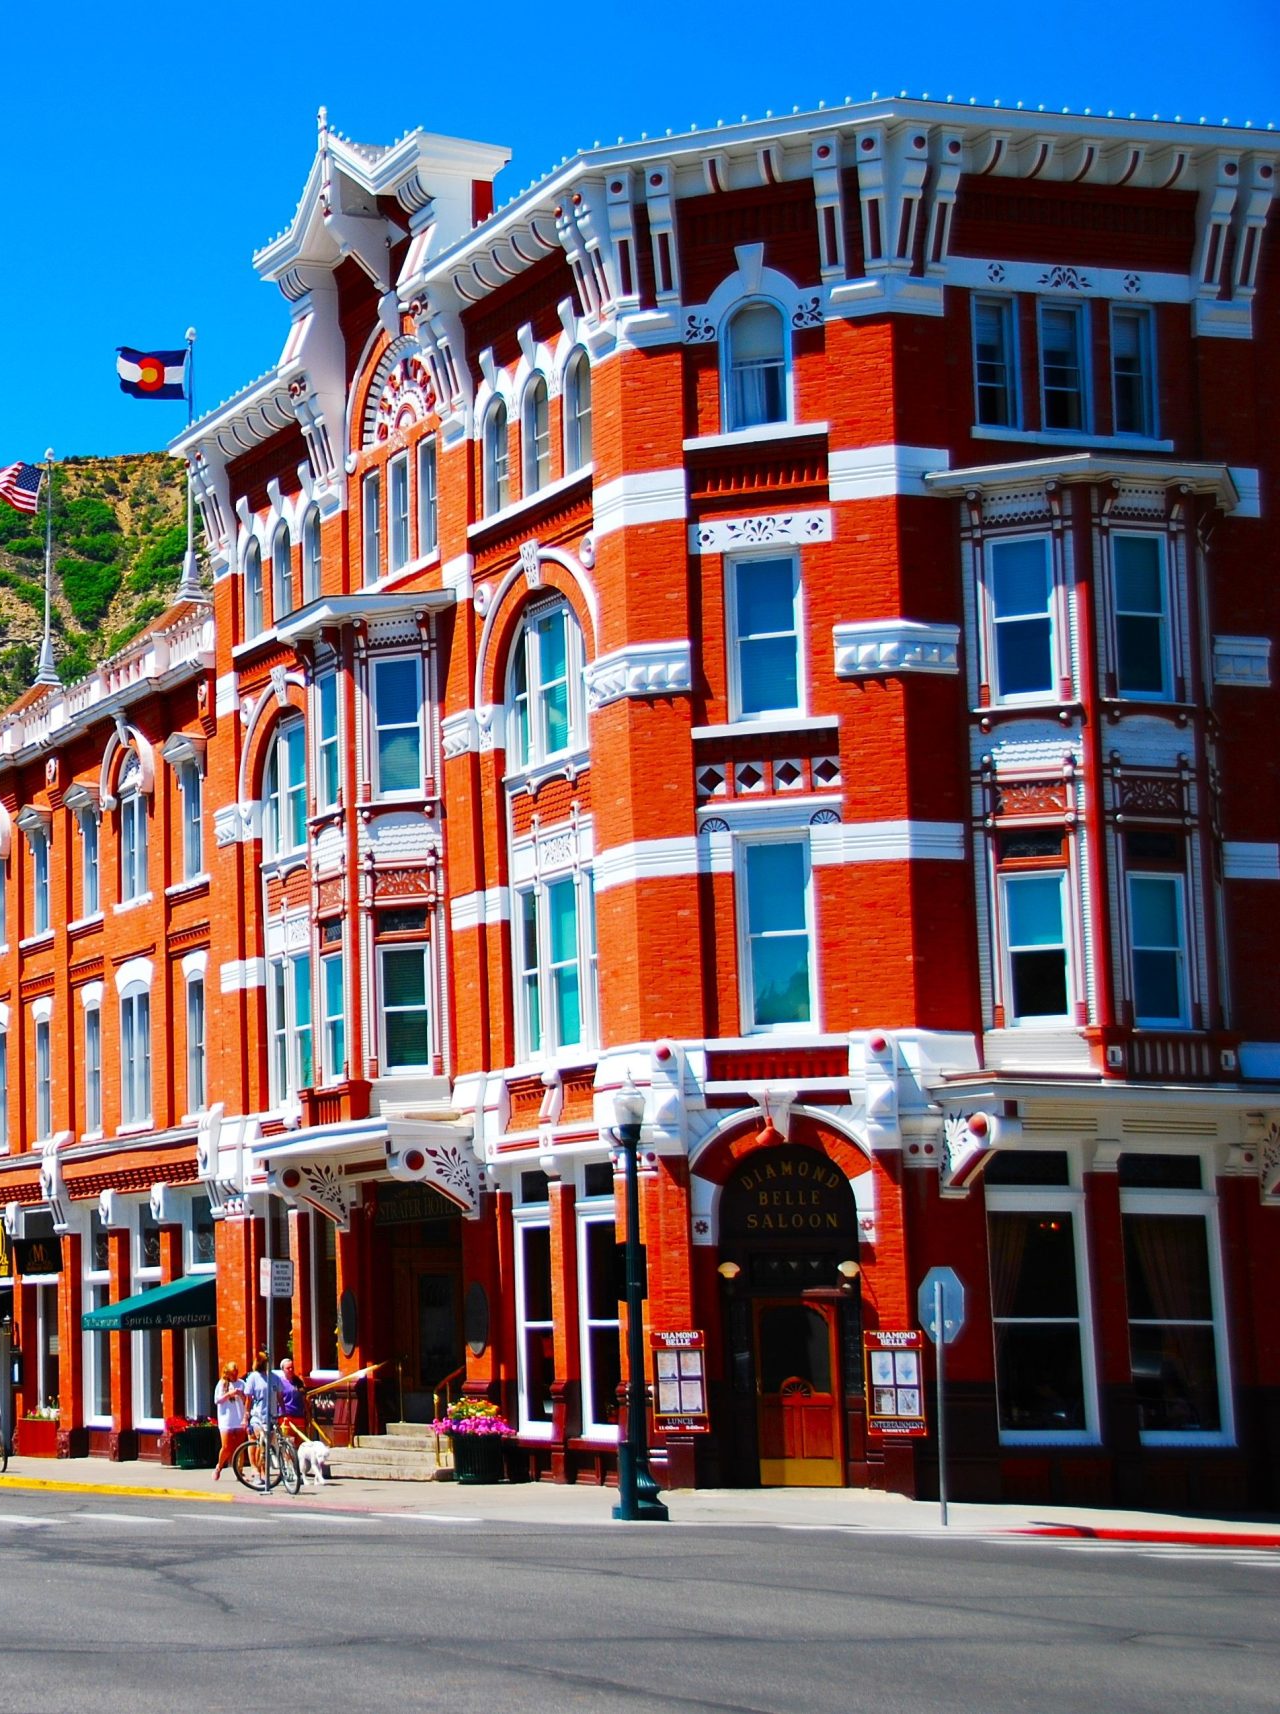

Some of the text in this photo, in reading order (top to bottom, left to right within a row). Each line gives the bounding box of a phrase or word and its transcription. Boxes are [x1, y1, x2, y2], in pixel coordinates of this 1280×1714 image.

[741, 1161, 840, 1190] DIAMOND
[759, 1190, 821, 1206] BELLE
[747, 1213, 839, 1229] SALOON
[125, 1315, 153, 1326] Spirits
[155, 1315, 162, 1323] &
[166, 1313, 211, 1324] Appetizers
[666, 1338, 691, 1346] BELLE
[880, 1338, 907, 1346] BELLE
[870, 1420, 924, 1429] ENTERTAINMENT
